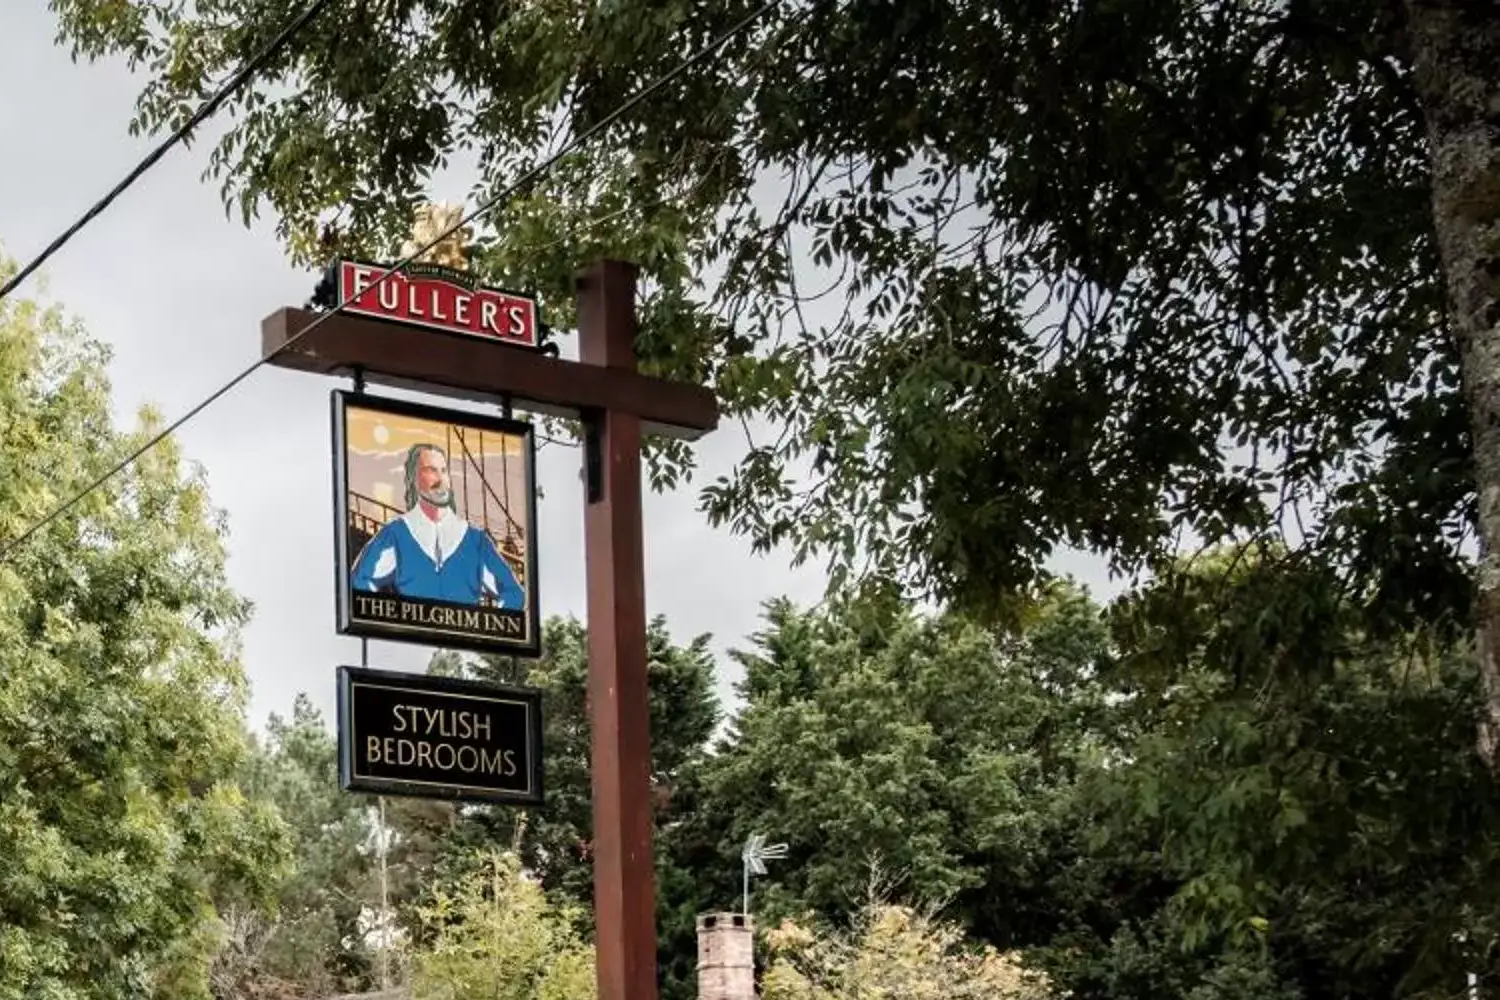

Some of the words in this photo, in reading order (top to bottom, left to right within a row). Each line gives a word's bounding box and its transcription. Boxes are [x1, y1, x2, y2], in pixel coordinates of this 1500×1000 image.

[353, 267, 526, 336] FULLER'S
[356, 596, 397, 618] THE
[400, 602, 480, 629] PILGRIM
[484, 613, 521, 633] INN
[392, 703, 492, 741] STYLISH
[366, 735, 518, 777] BEDROOMS
